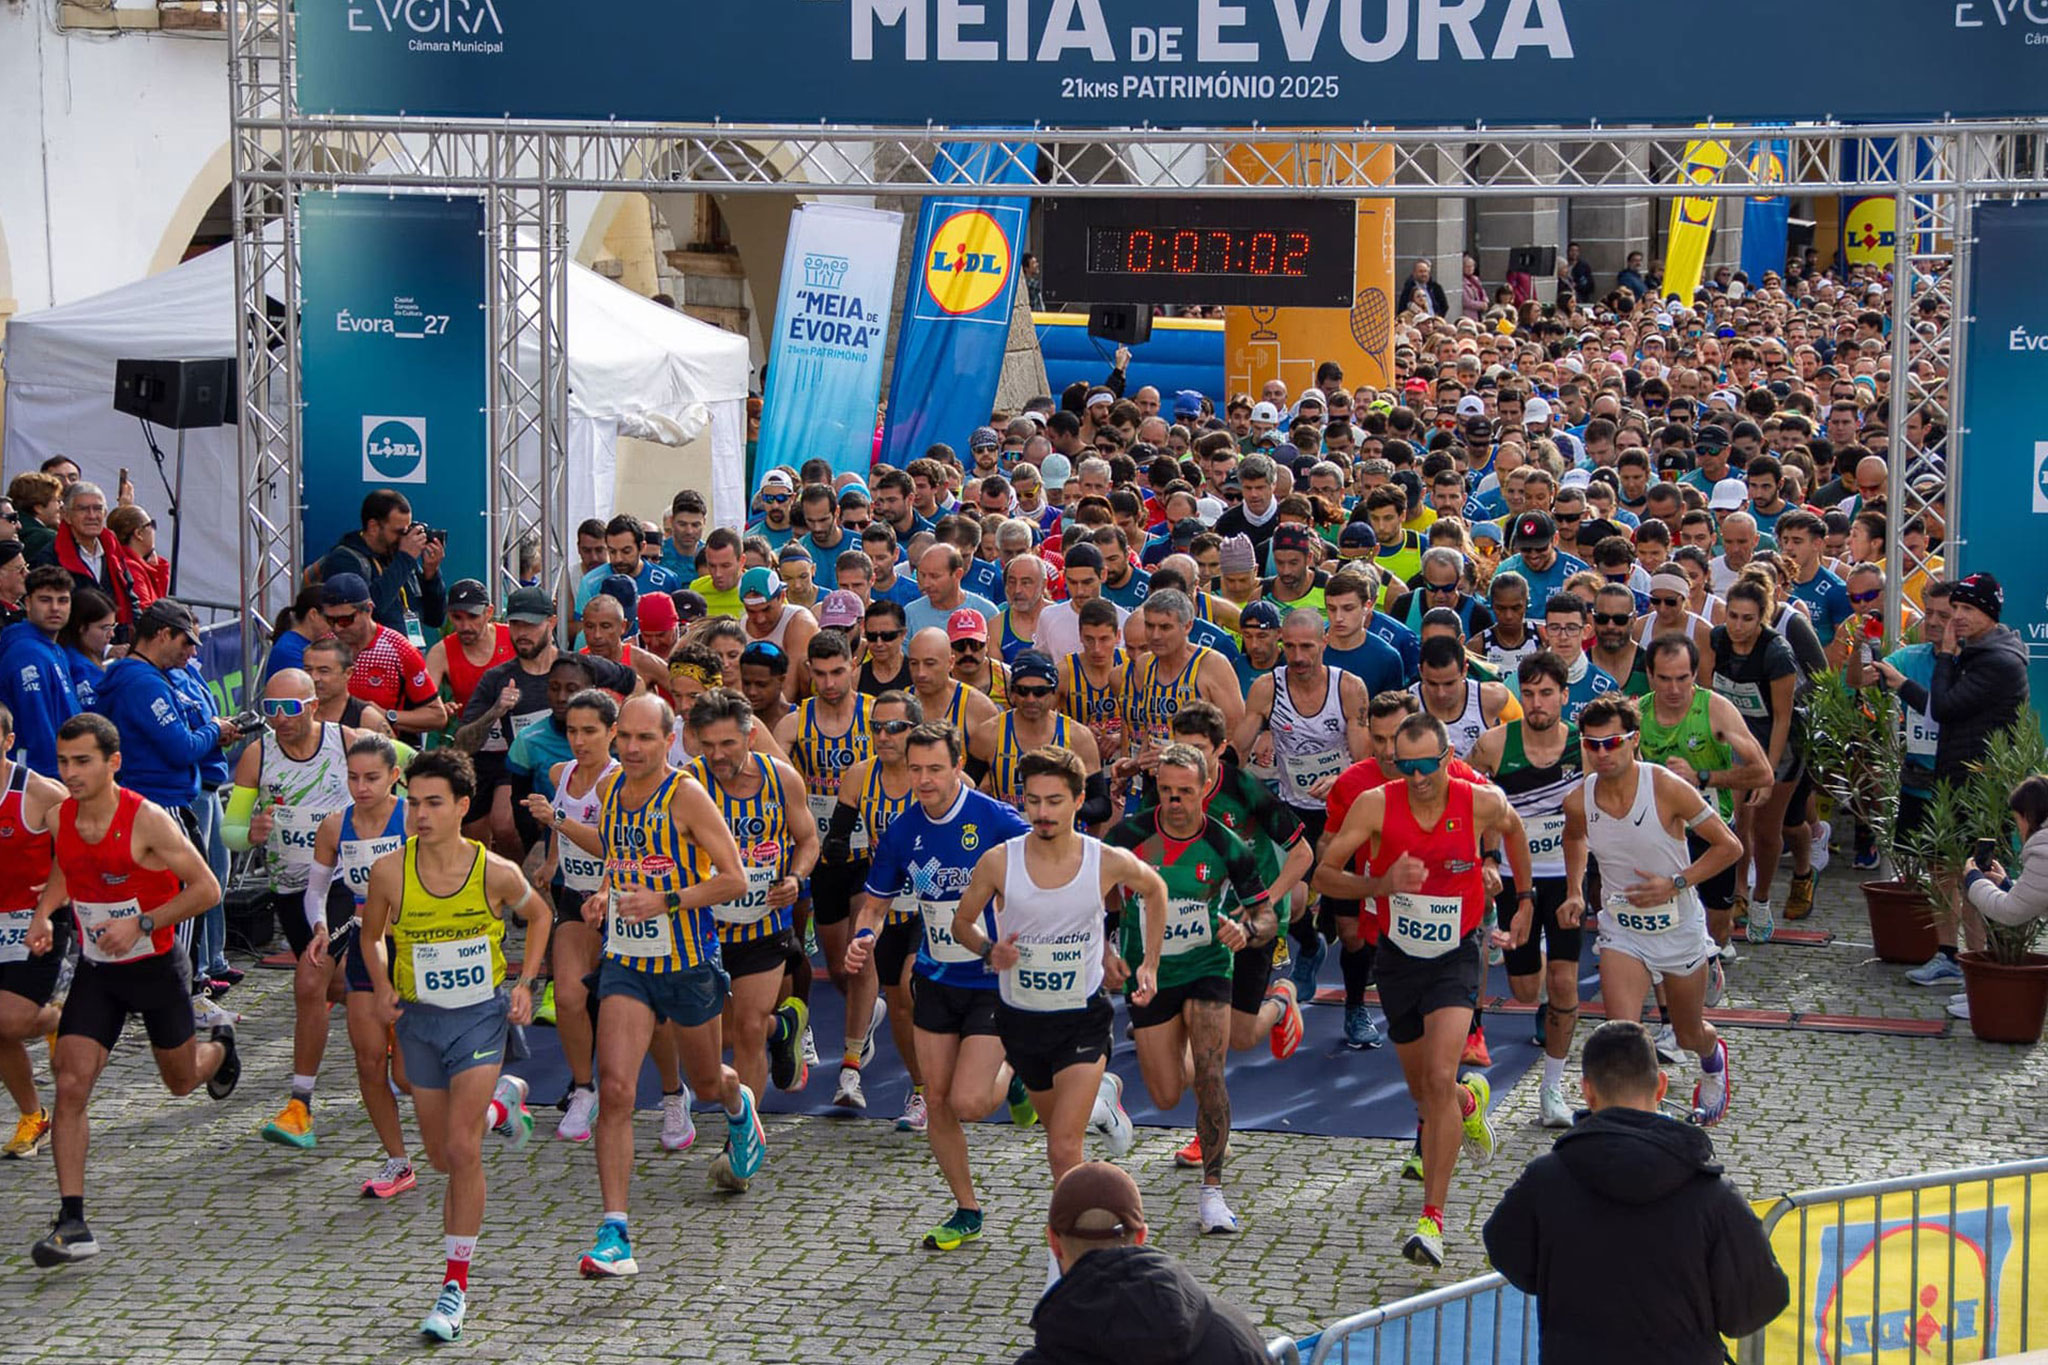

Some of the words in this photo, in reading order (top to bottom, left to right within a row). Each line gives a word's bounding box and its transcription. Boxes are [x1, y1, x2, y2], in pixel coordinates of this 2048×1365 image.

[408, 39, 450, 51] Câmara
[452, 40, 503, 54] Municipal
[1131, 27, 1183, 61] DE
[1061, 77, 1118, 98] 21KMS
[1122, 71, 1274, 98] PATRIMÓNIO
[1280, 76, 1339, 98] 2025
[1128, 230, 1310, 275] 0:07:02
[866, 313, 879, 323] DE
[816, 749, 855, 769] LKO
[613, 823, 648, 849] LKO
[371, 842, 398, 854] 10KM
[564, 857, 605, 877] 6597
[750, 871, 774, 883] 10KM
[1430, 904, 1458, 914] 10KM
[1397, 916, 1452, 942] 5620
[1617, 912, 1671, 931] 6633
[457, 943, 487, 958] 10KM
[1051, 950, 1082, 962] 10KM
[424, 965, 486, 991] 6350
[1018, 968, 1077, 992] 5597
